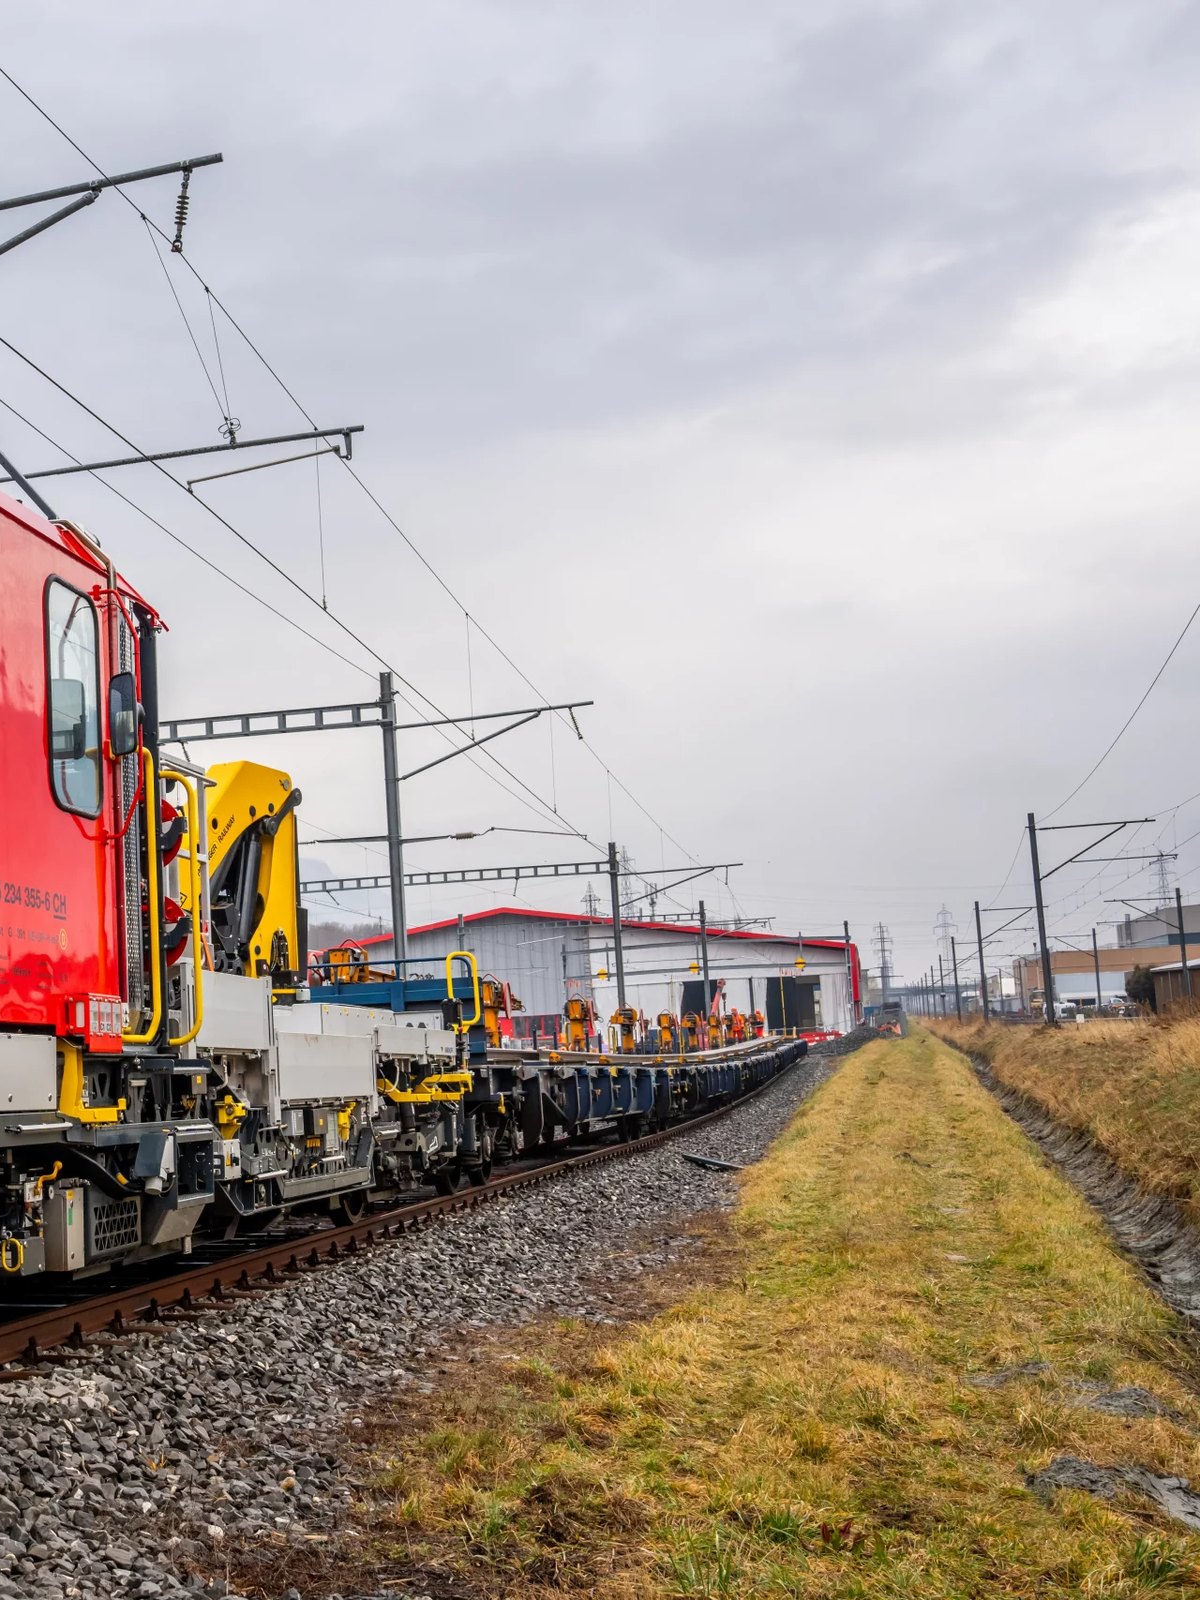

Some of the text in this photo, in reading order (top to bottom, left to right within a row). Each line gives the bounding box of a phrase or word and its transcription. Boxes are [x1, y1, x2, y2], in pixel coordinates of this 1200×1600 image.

[217, 814, 236, 844] RAILWAY
[4, 883, 22, 905] 234
[24, 887, 51, 912] 355-6
[53, 893, 67, 915] CH
